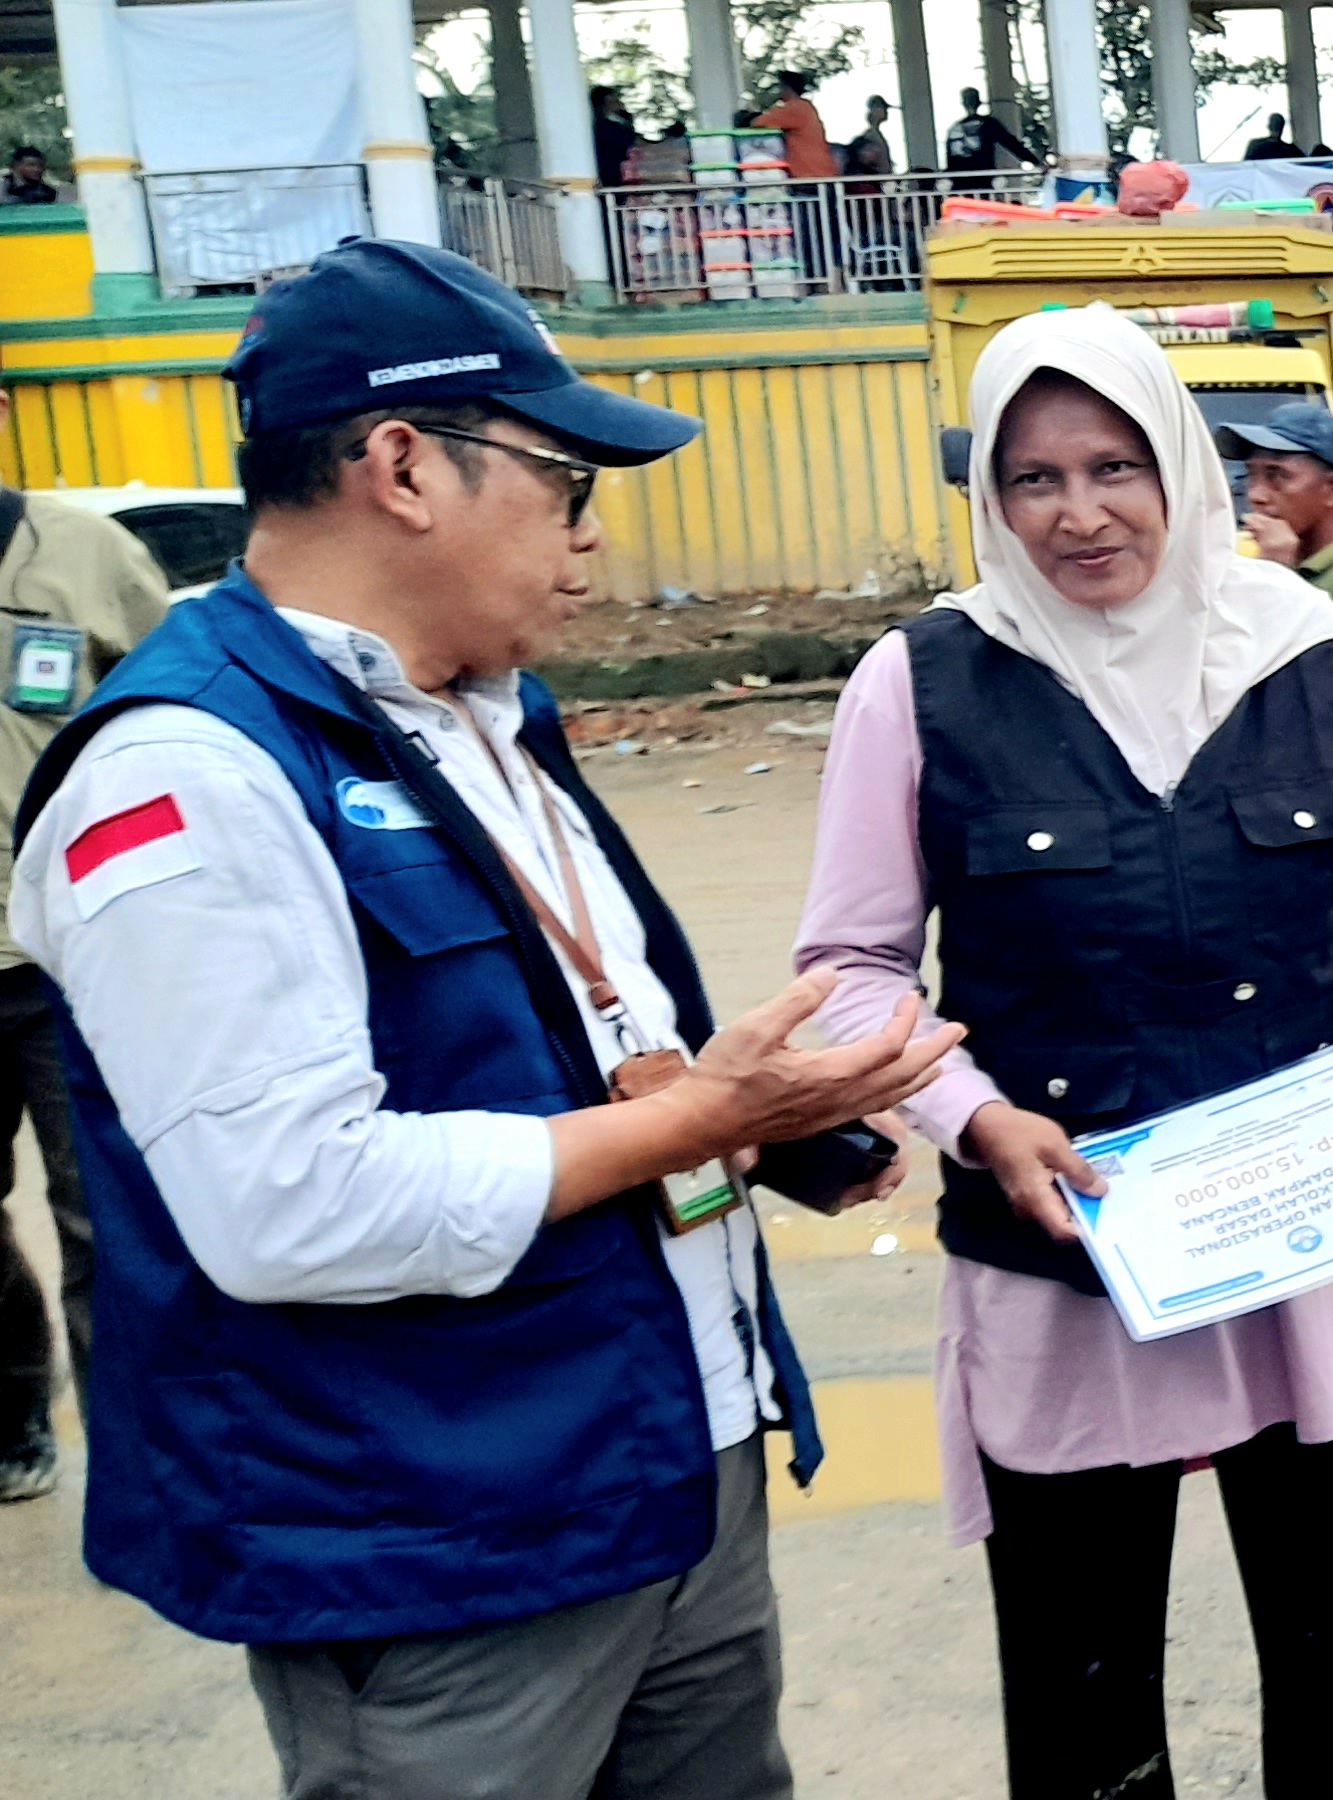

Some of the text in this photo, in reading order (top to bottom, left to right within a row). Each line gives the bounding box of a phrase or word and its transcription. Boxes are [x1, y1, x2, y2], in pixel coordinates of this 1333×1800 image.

[1175, 1152, 1304, 1208] 15.000.000
[1179, 1195, 1262, 1230] BENCANA
[1214, 1207, 1272, 1235] DASAR
[1185, 1210, 1307, 1259] OPERASIONAL
